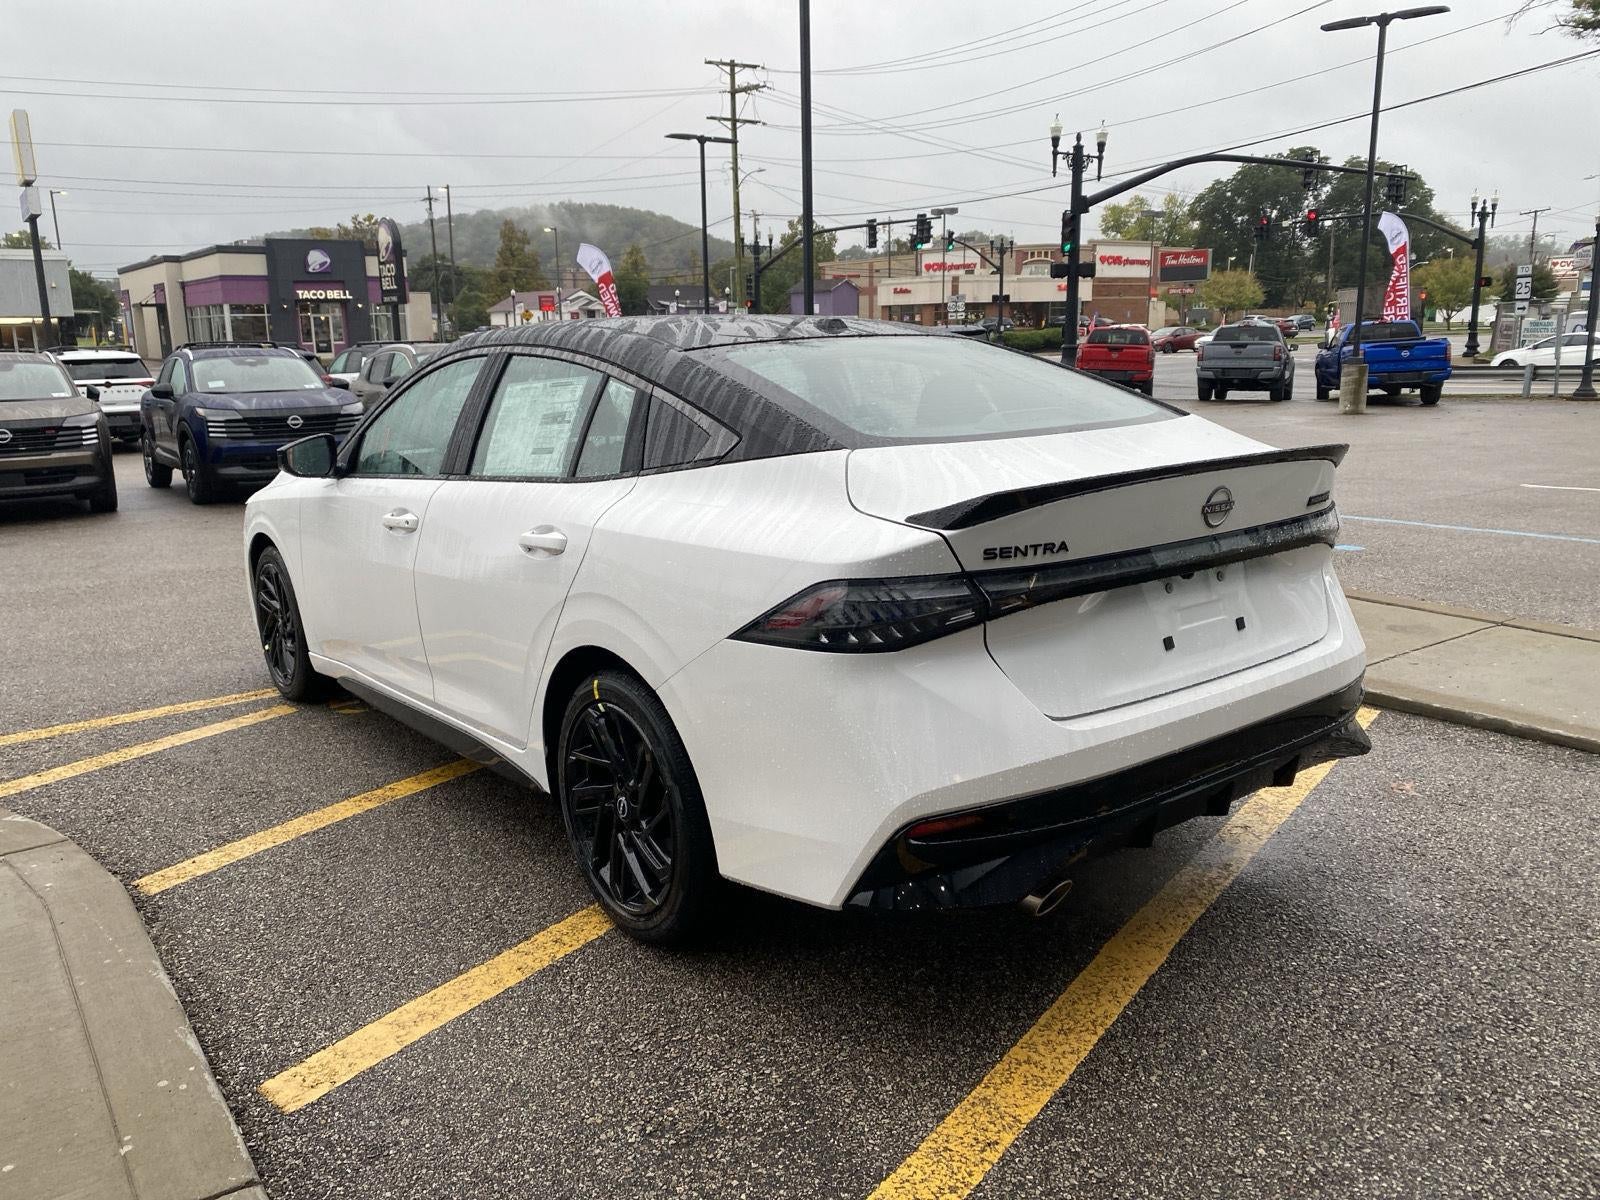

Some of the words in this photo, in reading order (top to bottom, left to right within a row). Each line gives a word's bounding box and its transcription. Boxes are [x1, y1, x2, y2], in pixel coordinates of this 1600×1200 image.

[1107, 255, 1123, 266] CVS
[1123, 257, 1150, 268] pharmacy
[1164, 255, 1178, 266] Tim
[1178, 253, 1205, 265] Hortons
[379, 263, 396, 278] TACO
[930, 262, 947, 272] CVS
[947, 262, 977, 272] pharmacy
[381, 277, 398, 290] BELL
[1516, 281, 1531, 295] 25
[296, 290, 325, 300] TACO
[326, 290, 353, 300] BELL
[983, 540, 1069, 560] SENTRA
